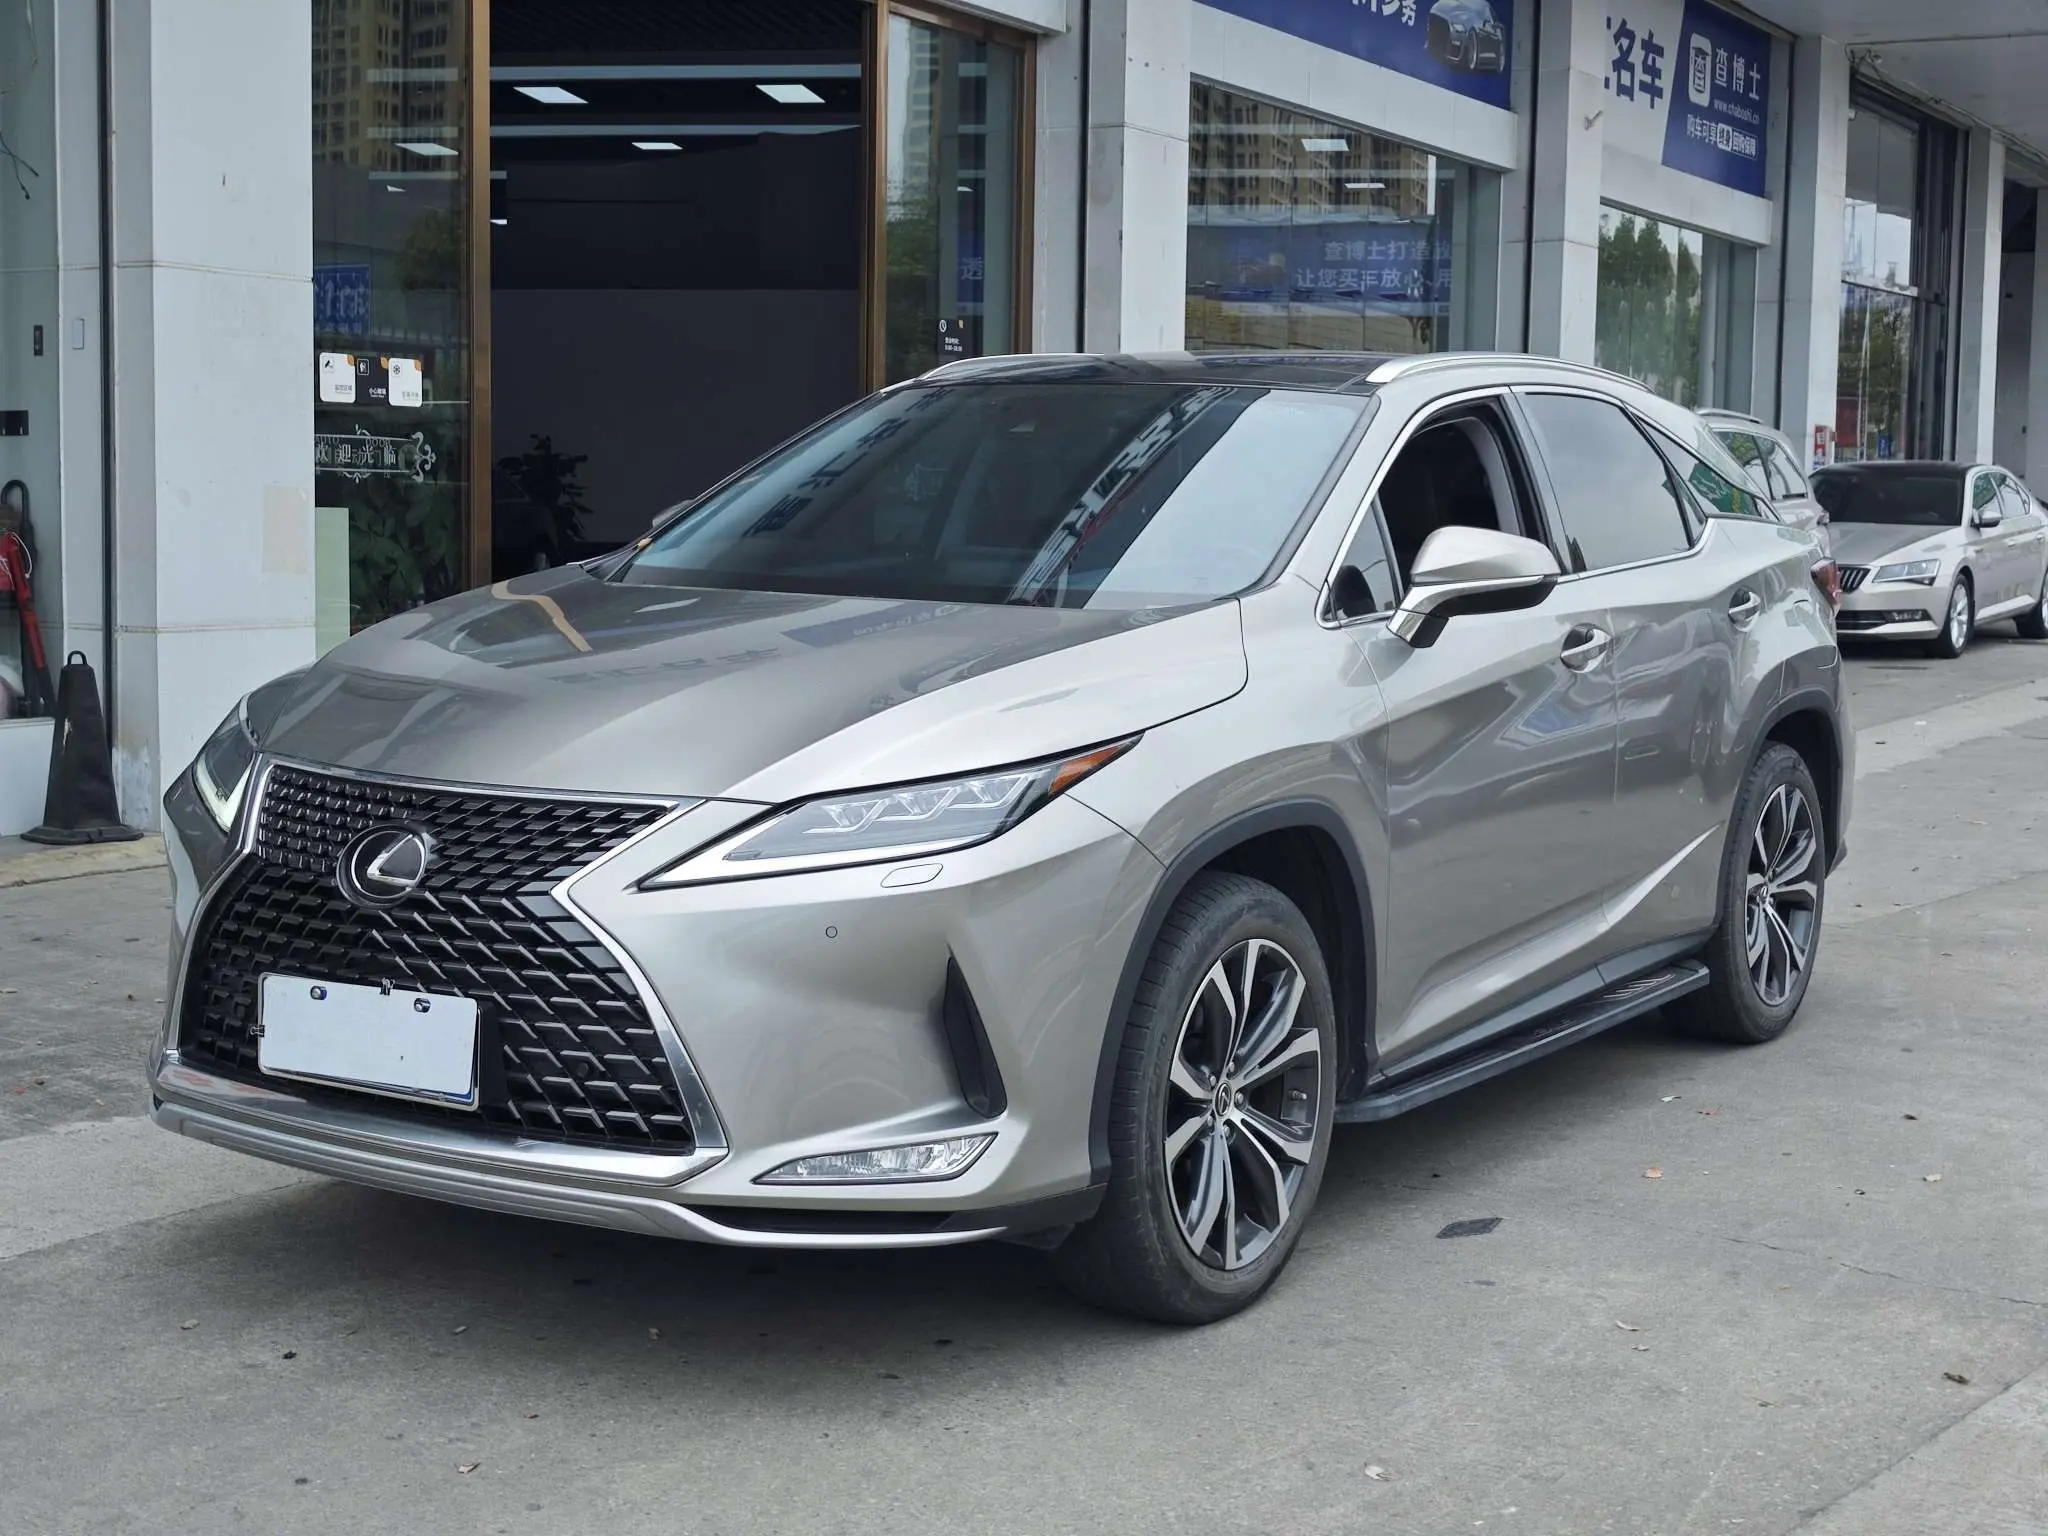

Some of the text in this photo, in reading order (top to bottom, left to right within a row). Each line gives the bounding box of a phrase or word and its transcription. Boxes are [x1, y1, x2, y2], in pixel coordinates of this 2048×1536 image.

[1604, 16, 1665, 109] 名车
[1714, 47, 1761, 100] 查博士
